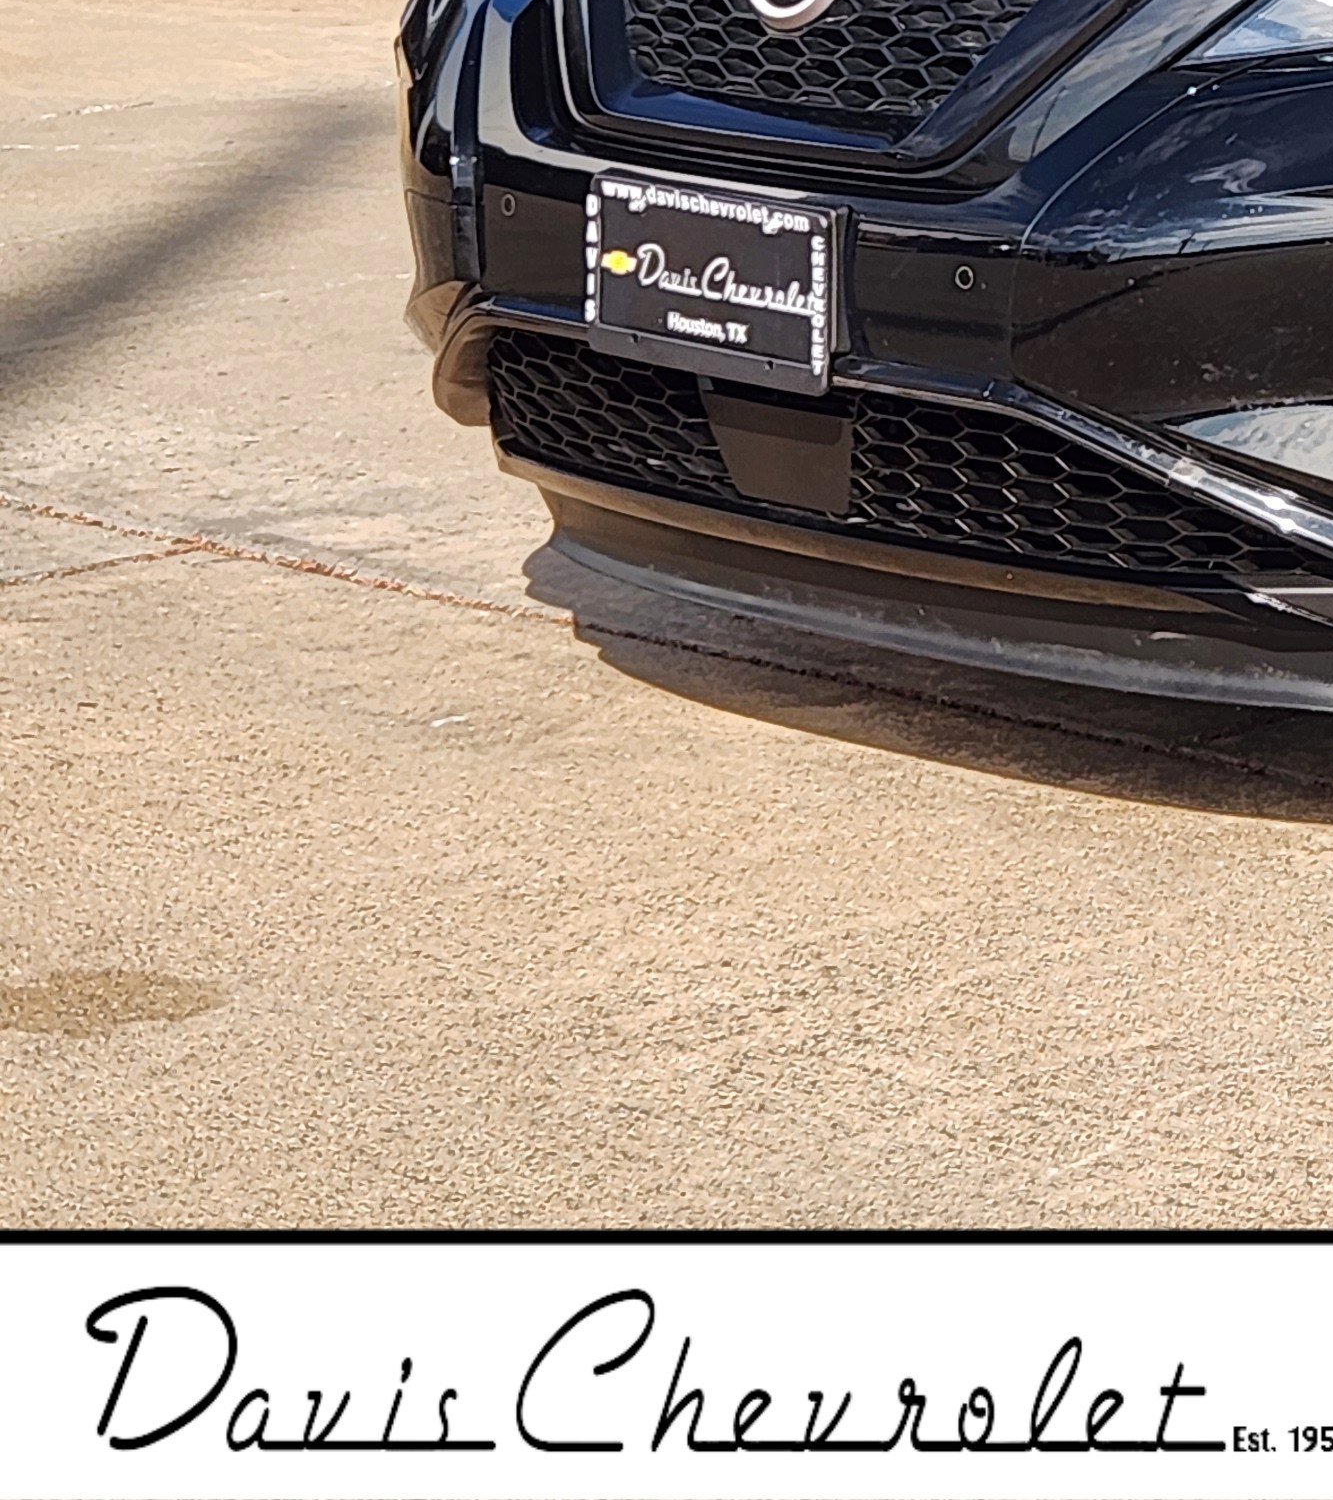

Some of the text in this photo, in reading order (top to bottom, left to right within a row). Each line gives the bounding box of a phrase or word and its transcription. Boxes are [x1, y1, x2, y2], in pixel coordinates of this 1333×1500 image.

[601, 180, 811, 232] www.davischevrolet.com
[585, 194, 600, 322] DAVIS
[636, 243, 818, 318] Davis Chevrolet
[666, 310, 750, 344] Houston, TX
[810, 235, 827, 376] CHEVROLET
